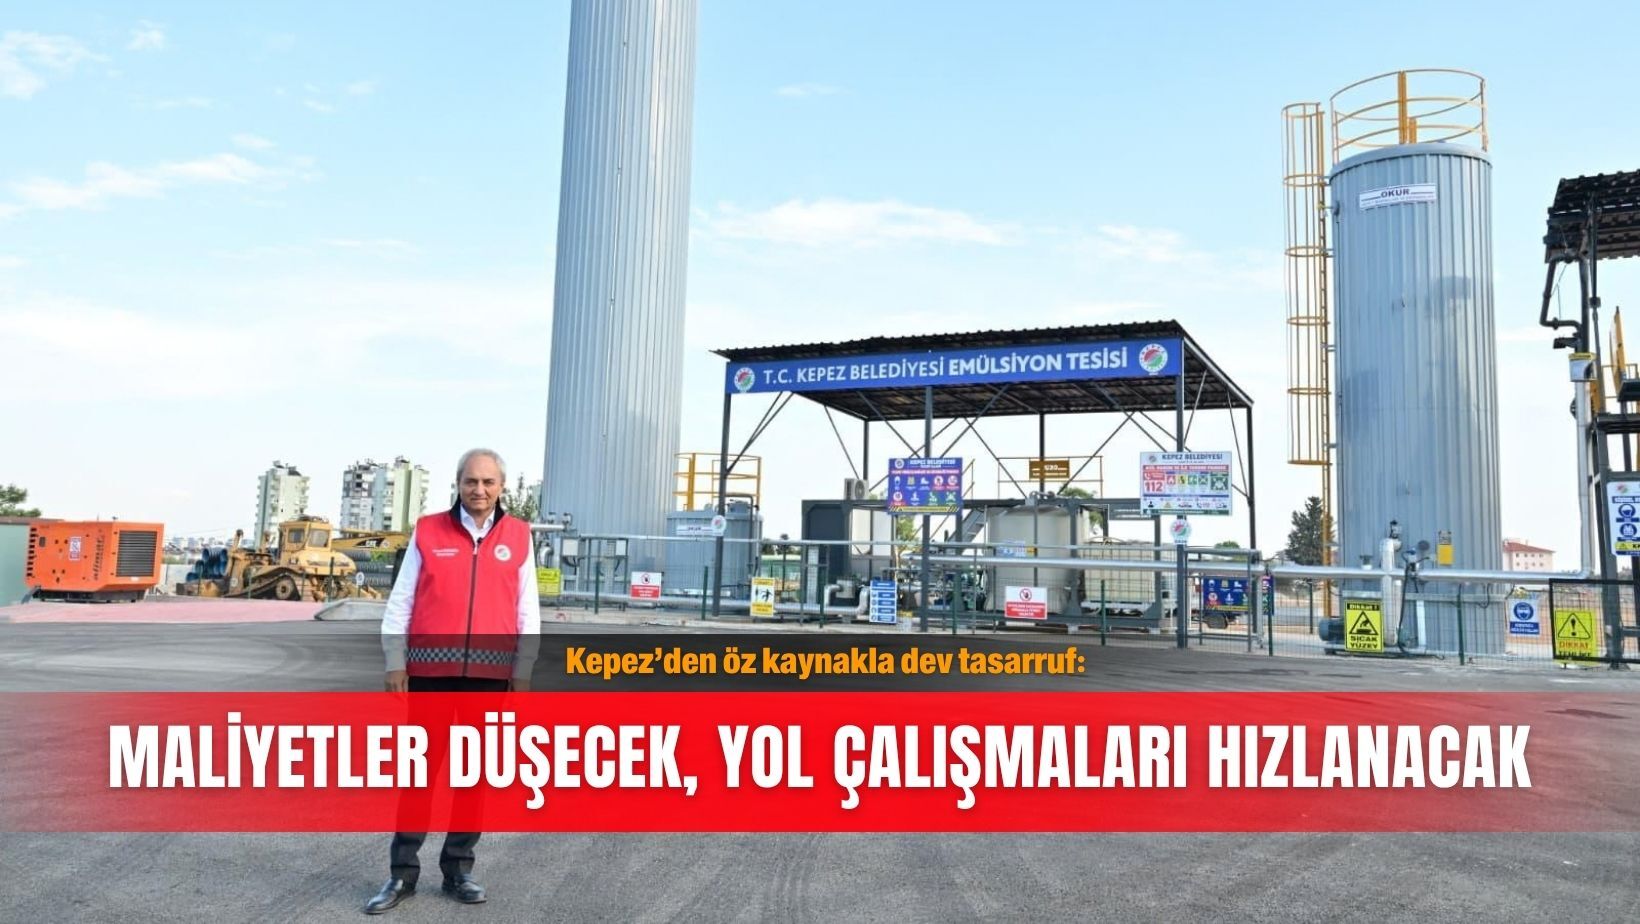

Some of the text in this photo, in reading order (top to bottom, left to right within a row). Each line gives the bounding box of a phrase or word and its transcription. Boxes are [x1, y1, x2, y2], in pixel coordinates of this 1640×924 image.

[1380, 188, 1410, 198] OKUR
[763, 346, 1128, 385] T.C. KEPEZ BELEDİYESİ EMÜLSİYON TESİSİ
[1144, 481, 1163, 492] 112
